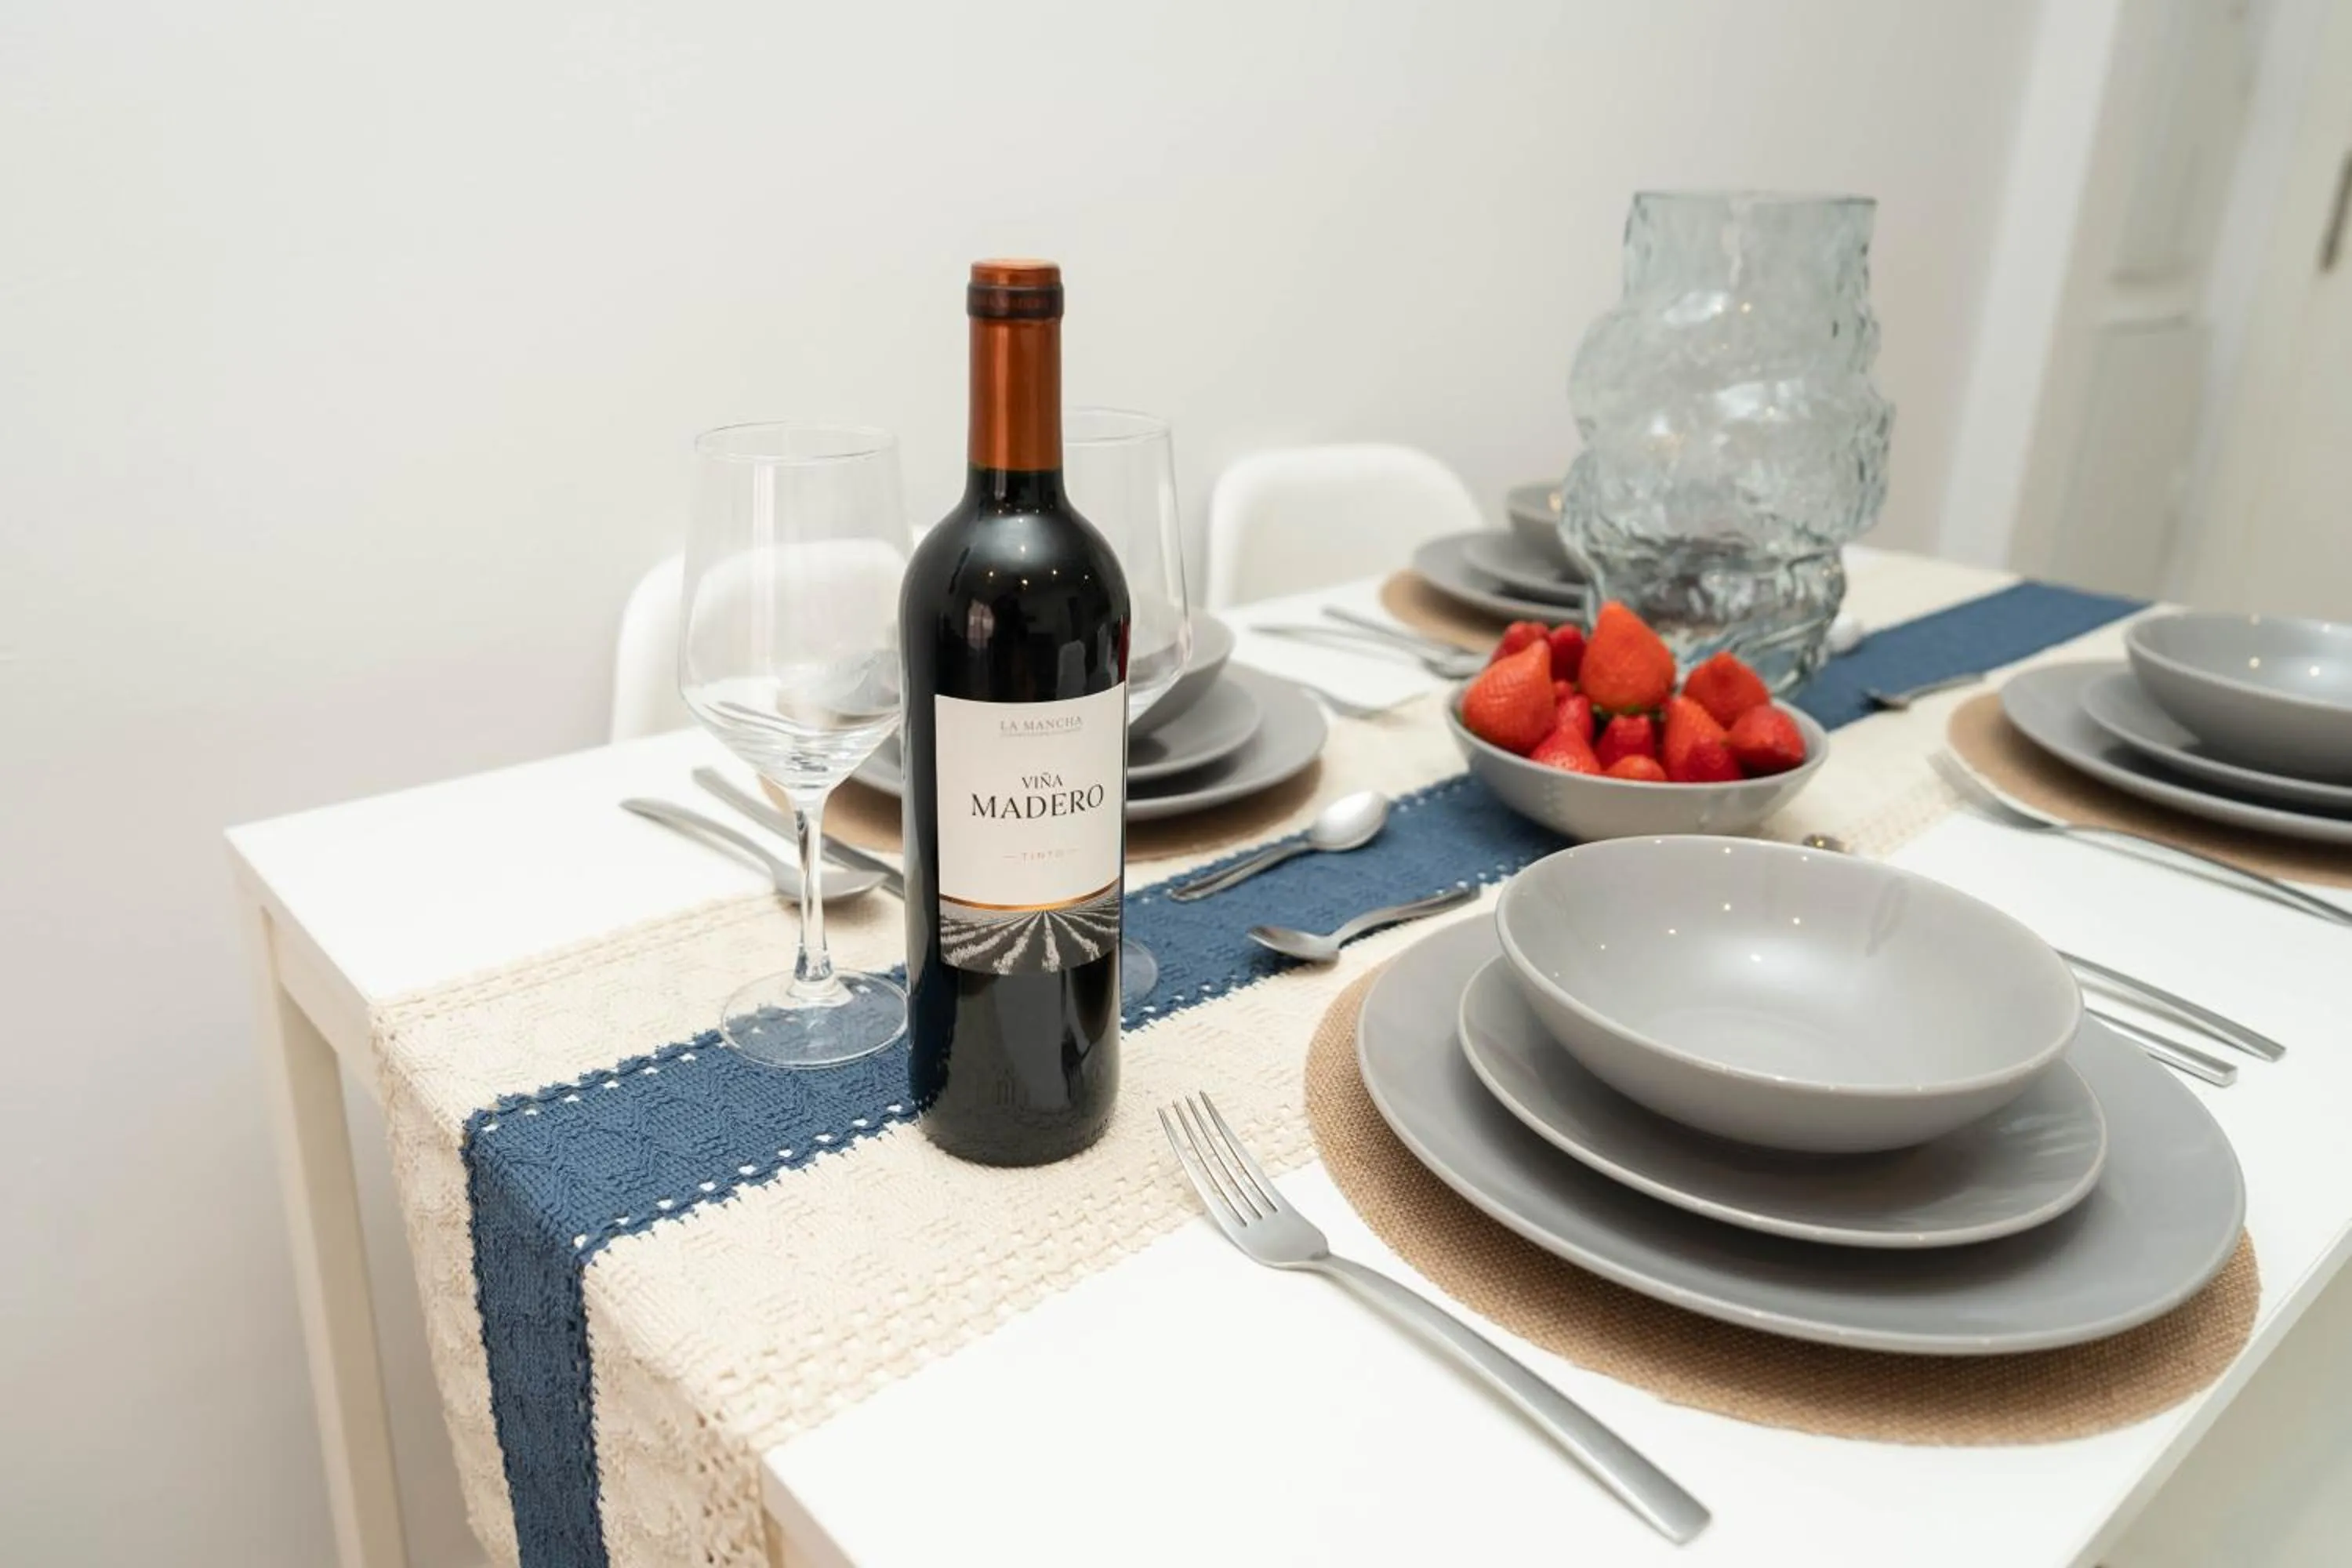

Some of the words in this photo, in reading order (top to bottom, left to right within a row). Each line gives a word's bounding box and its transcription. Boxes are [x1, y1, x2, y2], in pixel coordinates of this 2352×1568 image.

[1000, 720, 1018, 731] LA
[1024, 716, 1083, 731] MANCHA
[1022, 772, 1063, 789] VIÑA
[971, 783, 1104, 819] MADERO
